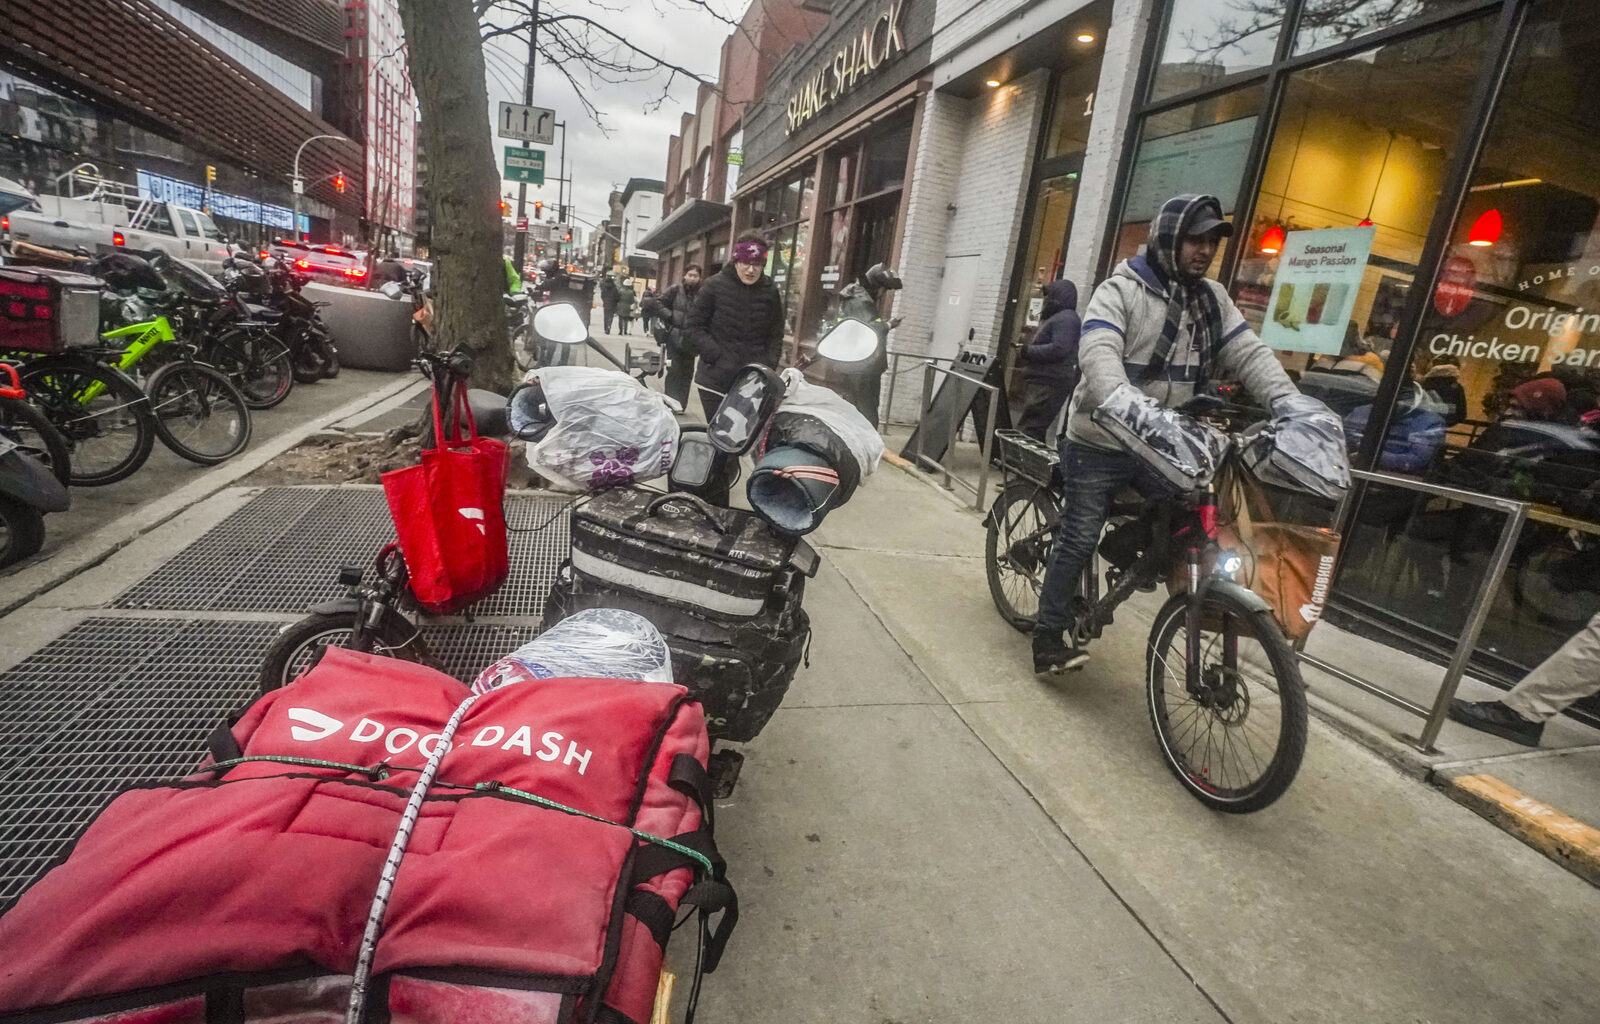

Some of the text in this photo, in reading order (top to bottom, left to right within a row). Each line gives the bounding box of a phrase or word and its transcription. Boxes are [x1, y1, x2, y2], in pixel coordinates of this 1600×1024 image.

[785, 1, 905, 136] SHAKE SHACK
[1288, 256, 1357, 269] Mango Passion
[1304, 243, 1347, 254] Seasonal
[1517, 266, 1576, 292] HOME
[1504, 306, 1600, 337] Origin
[1428, 333, 1541, 363] Chicken
[1311, 555, 1334, 604] GRUBHUB
[349, 717, 593, 776] DOODASH
